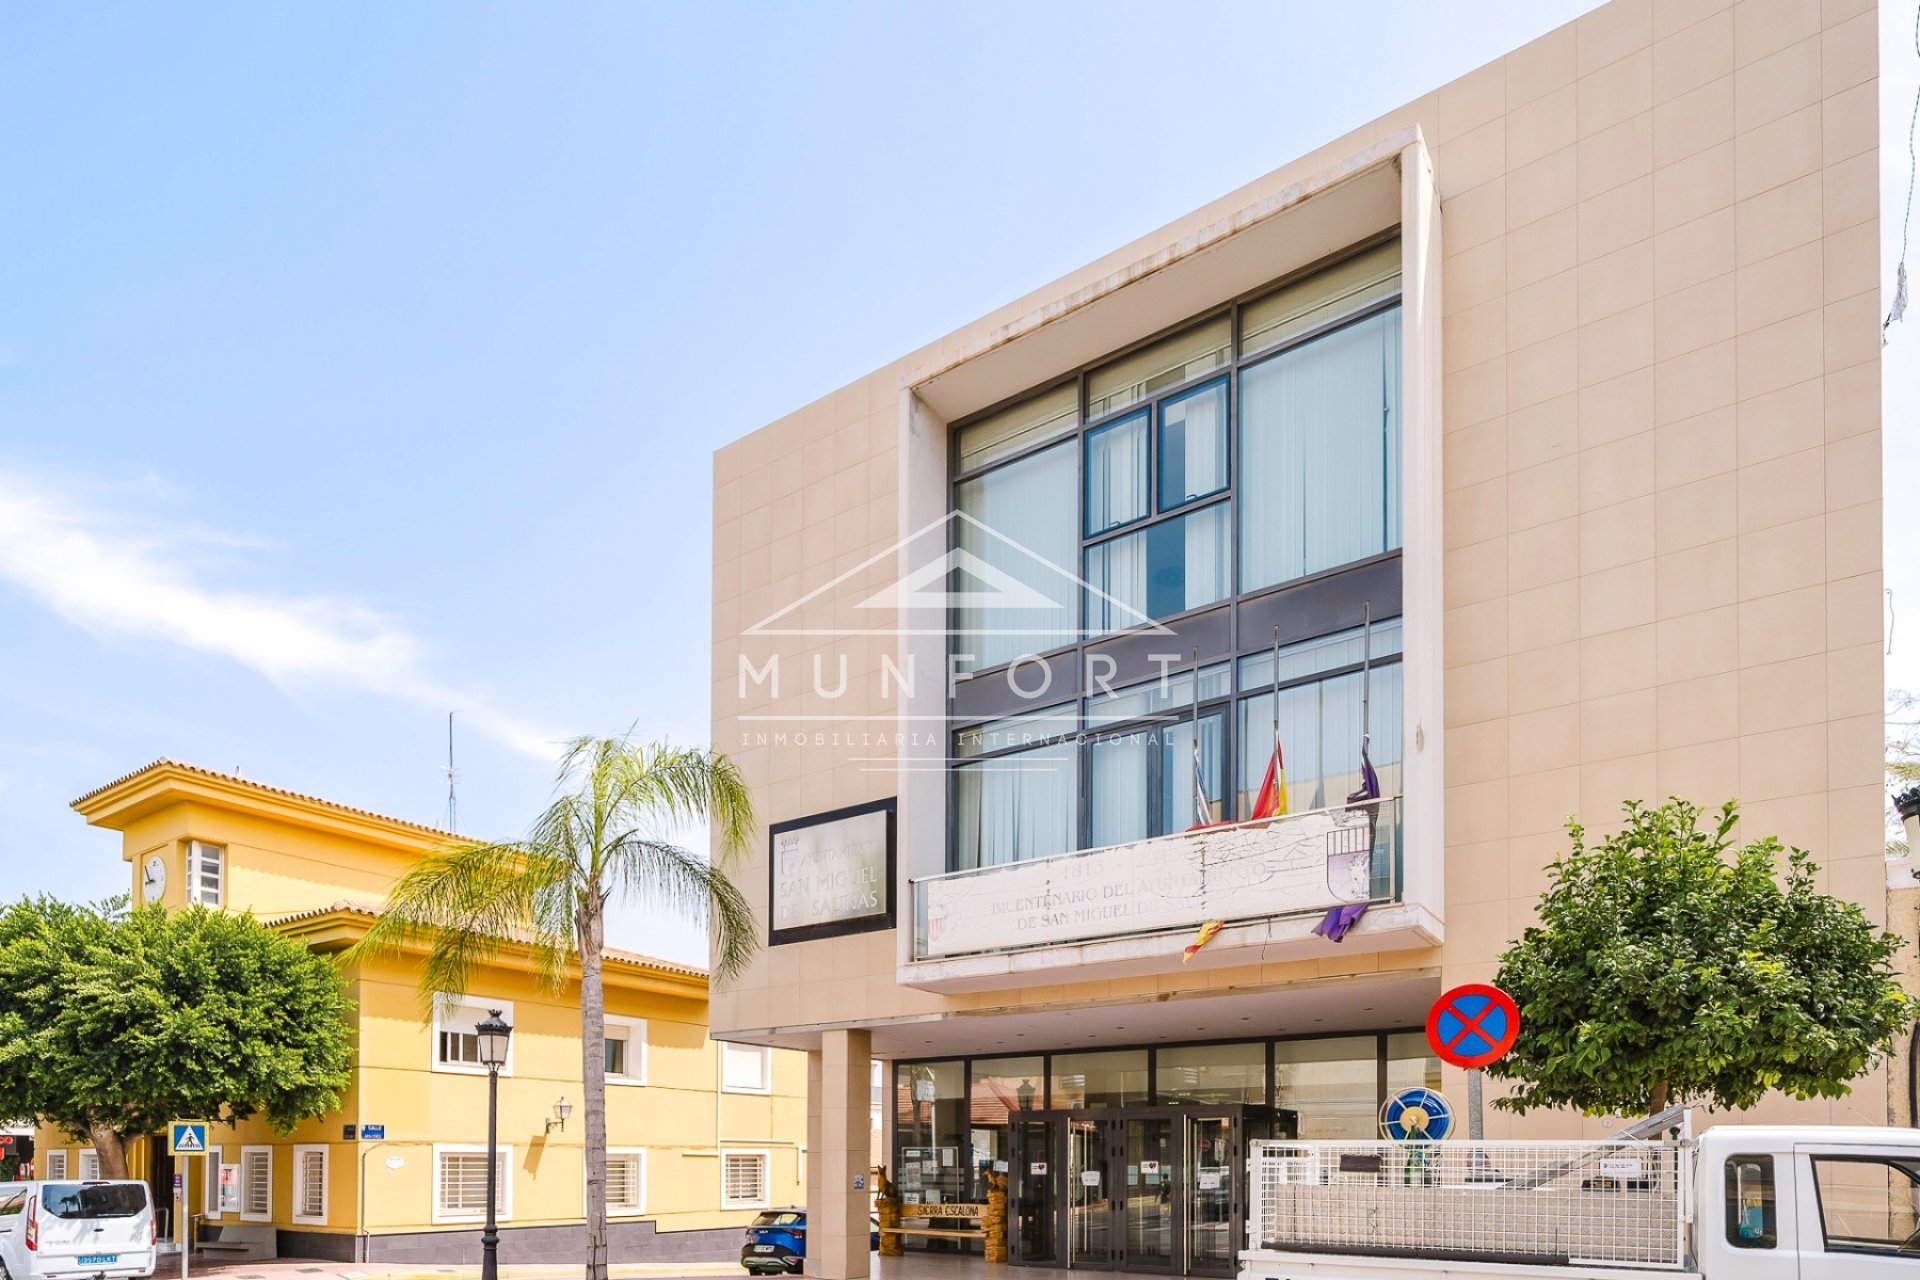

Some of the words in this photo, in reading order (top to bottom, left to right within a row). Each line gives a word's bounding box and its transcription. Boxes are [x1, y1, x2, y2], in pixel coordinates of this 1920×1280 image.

[780, 876, 809, 898] SAN
[816, 866, 878, 892] MIGUEL
[992, 888, 1097, 914] BICENTENARIO
[1103, 882, 1133, 899] DEL
[1137, 863, 1266, 893] AYUNTAENTO
[780, 903, 799, 922] DE
[812, 890, 878, 916] SALINAS
[1017, 917, 1036, 930] DE
[1041, 911, 1069, 928] SAN
[1074, 904, 1131, 924] MIGUEL
[917, 1205, 943, 1216] SIERRA
[944, 1205, 979, 1217] ESCALONA
